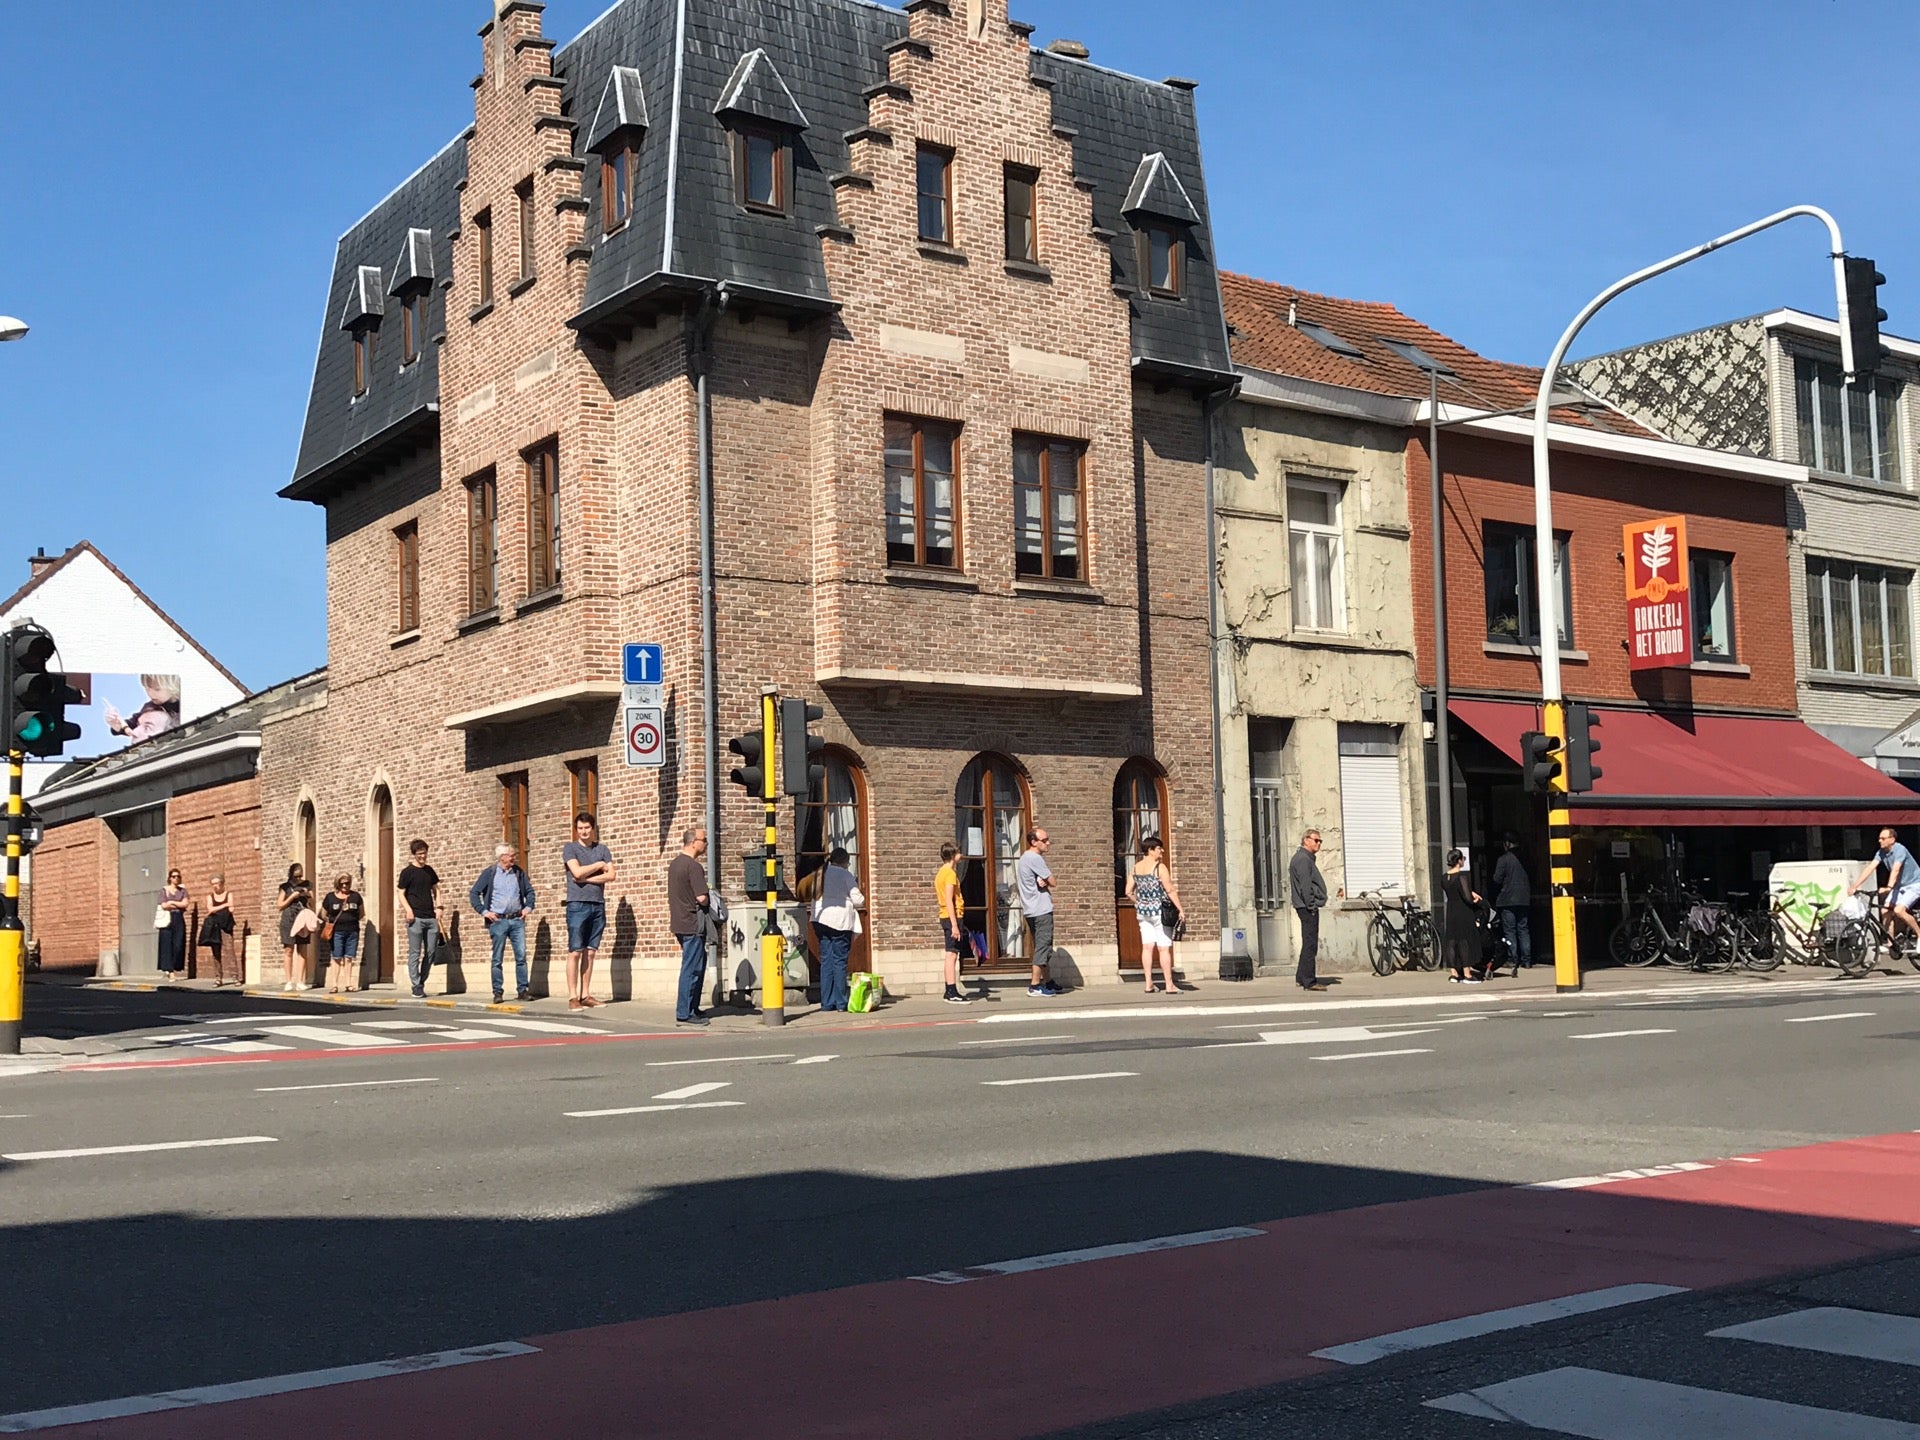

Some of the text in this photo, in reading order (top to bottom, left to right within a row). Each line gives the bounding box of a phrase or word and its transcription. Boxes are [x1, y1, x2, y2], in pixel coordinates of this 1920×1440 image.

[1634, 603, 1682, 631] BAKKERIJ
[1636, 629, 1684, 657] HET BROOD
[637, 732, 653, 744] 30
